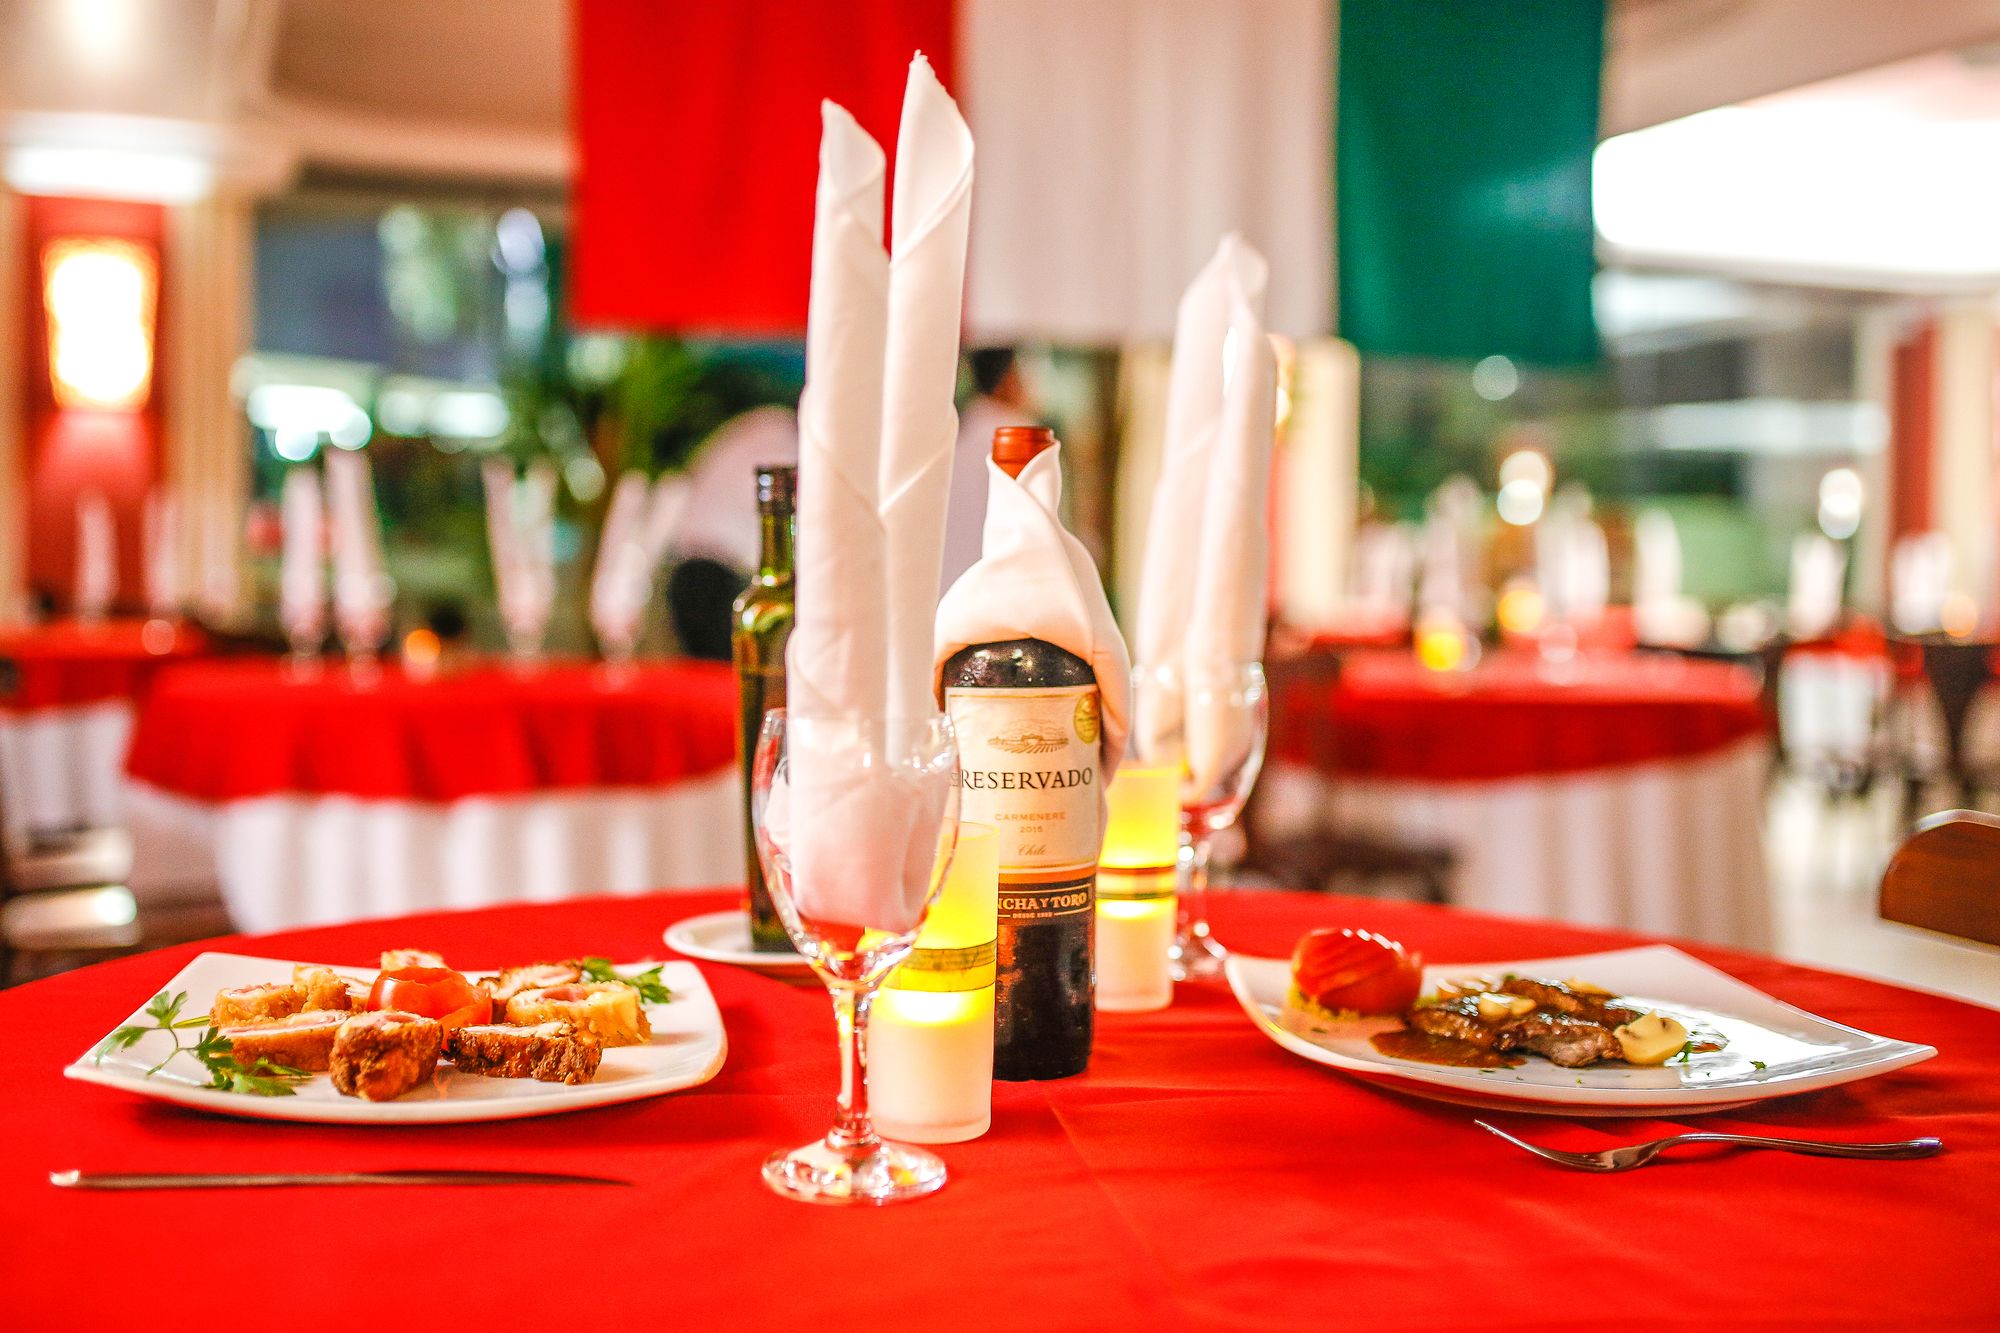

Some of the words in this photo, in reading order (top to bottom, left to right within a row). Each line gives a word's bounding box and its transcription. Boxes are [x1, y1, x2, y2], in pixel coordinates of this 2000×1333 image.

[961, 767, 1093, 789] RESERVADO
[995, 812, 1066, 821] CARMENERE
[1017, 844, 1047, 856] Chile
[1040, 898, 1050, 908] Y
[1050, 892, 1088, 909] TORO
